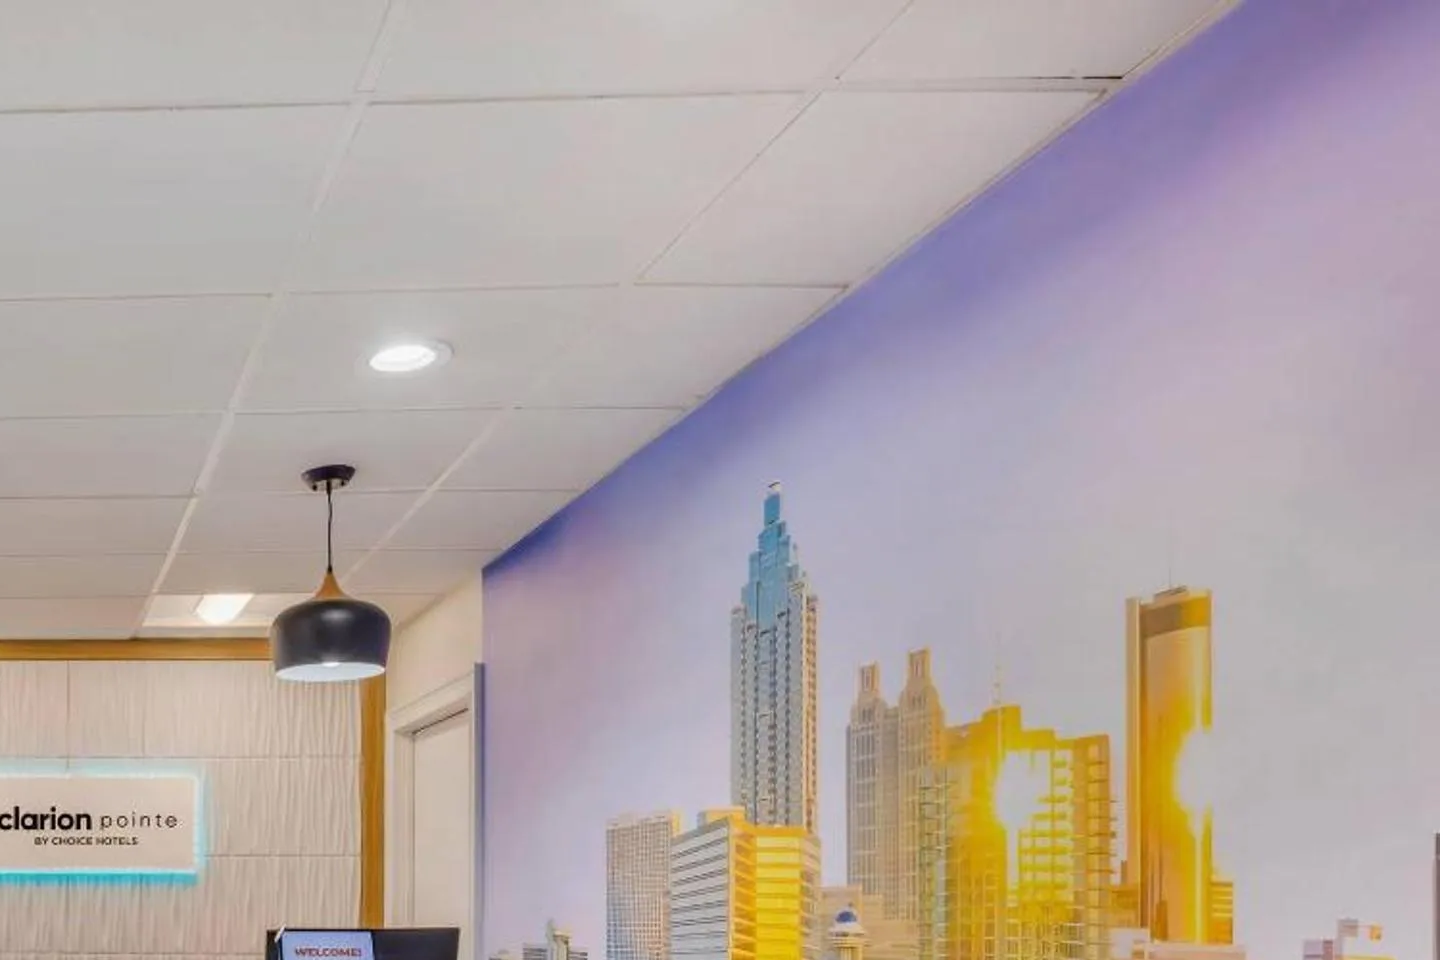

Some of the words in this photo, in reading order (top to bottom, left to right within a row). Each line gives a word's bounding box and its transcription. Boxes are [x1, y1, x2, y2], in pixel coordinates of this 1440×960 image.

[100, 811, 178, 830] pointe
[34, 837, 49, 845] BY
[51, 836, 93, 845] CHOICE
[96, 836, 139, 845] HOTELS
